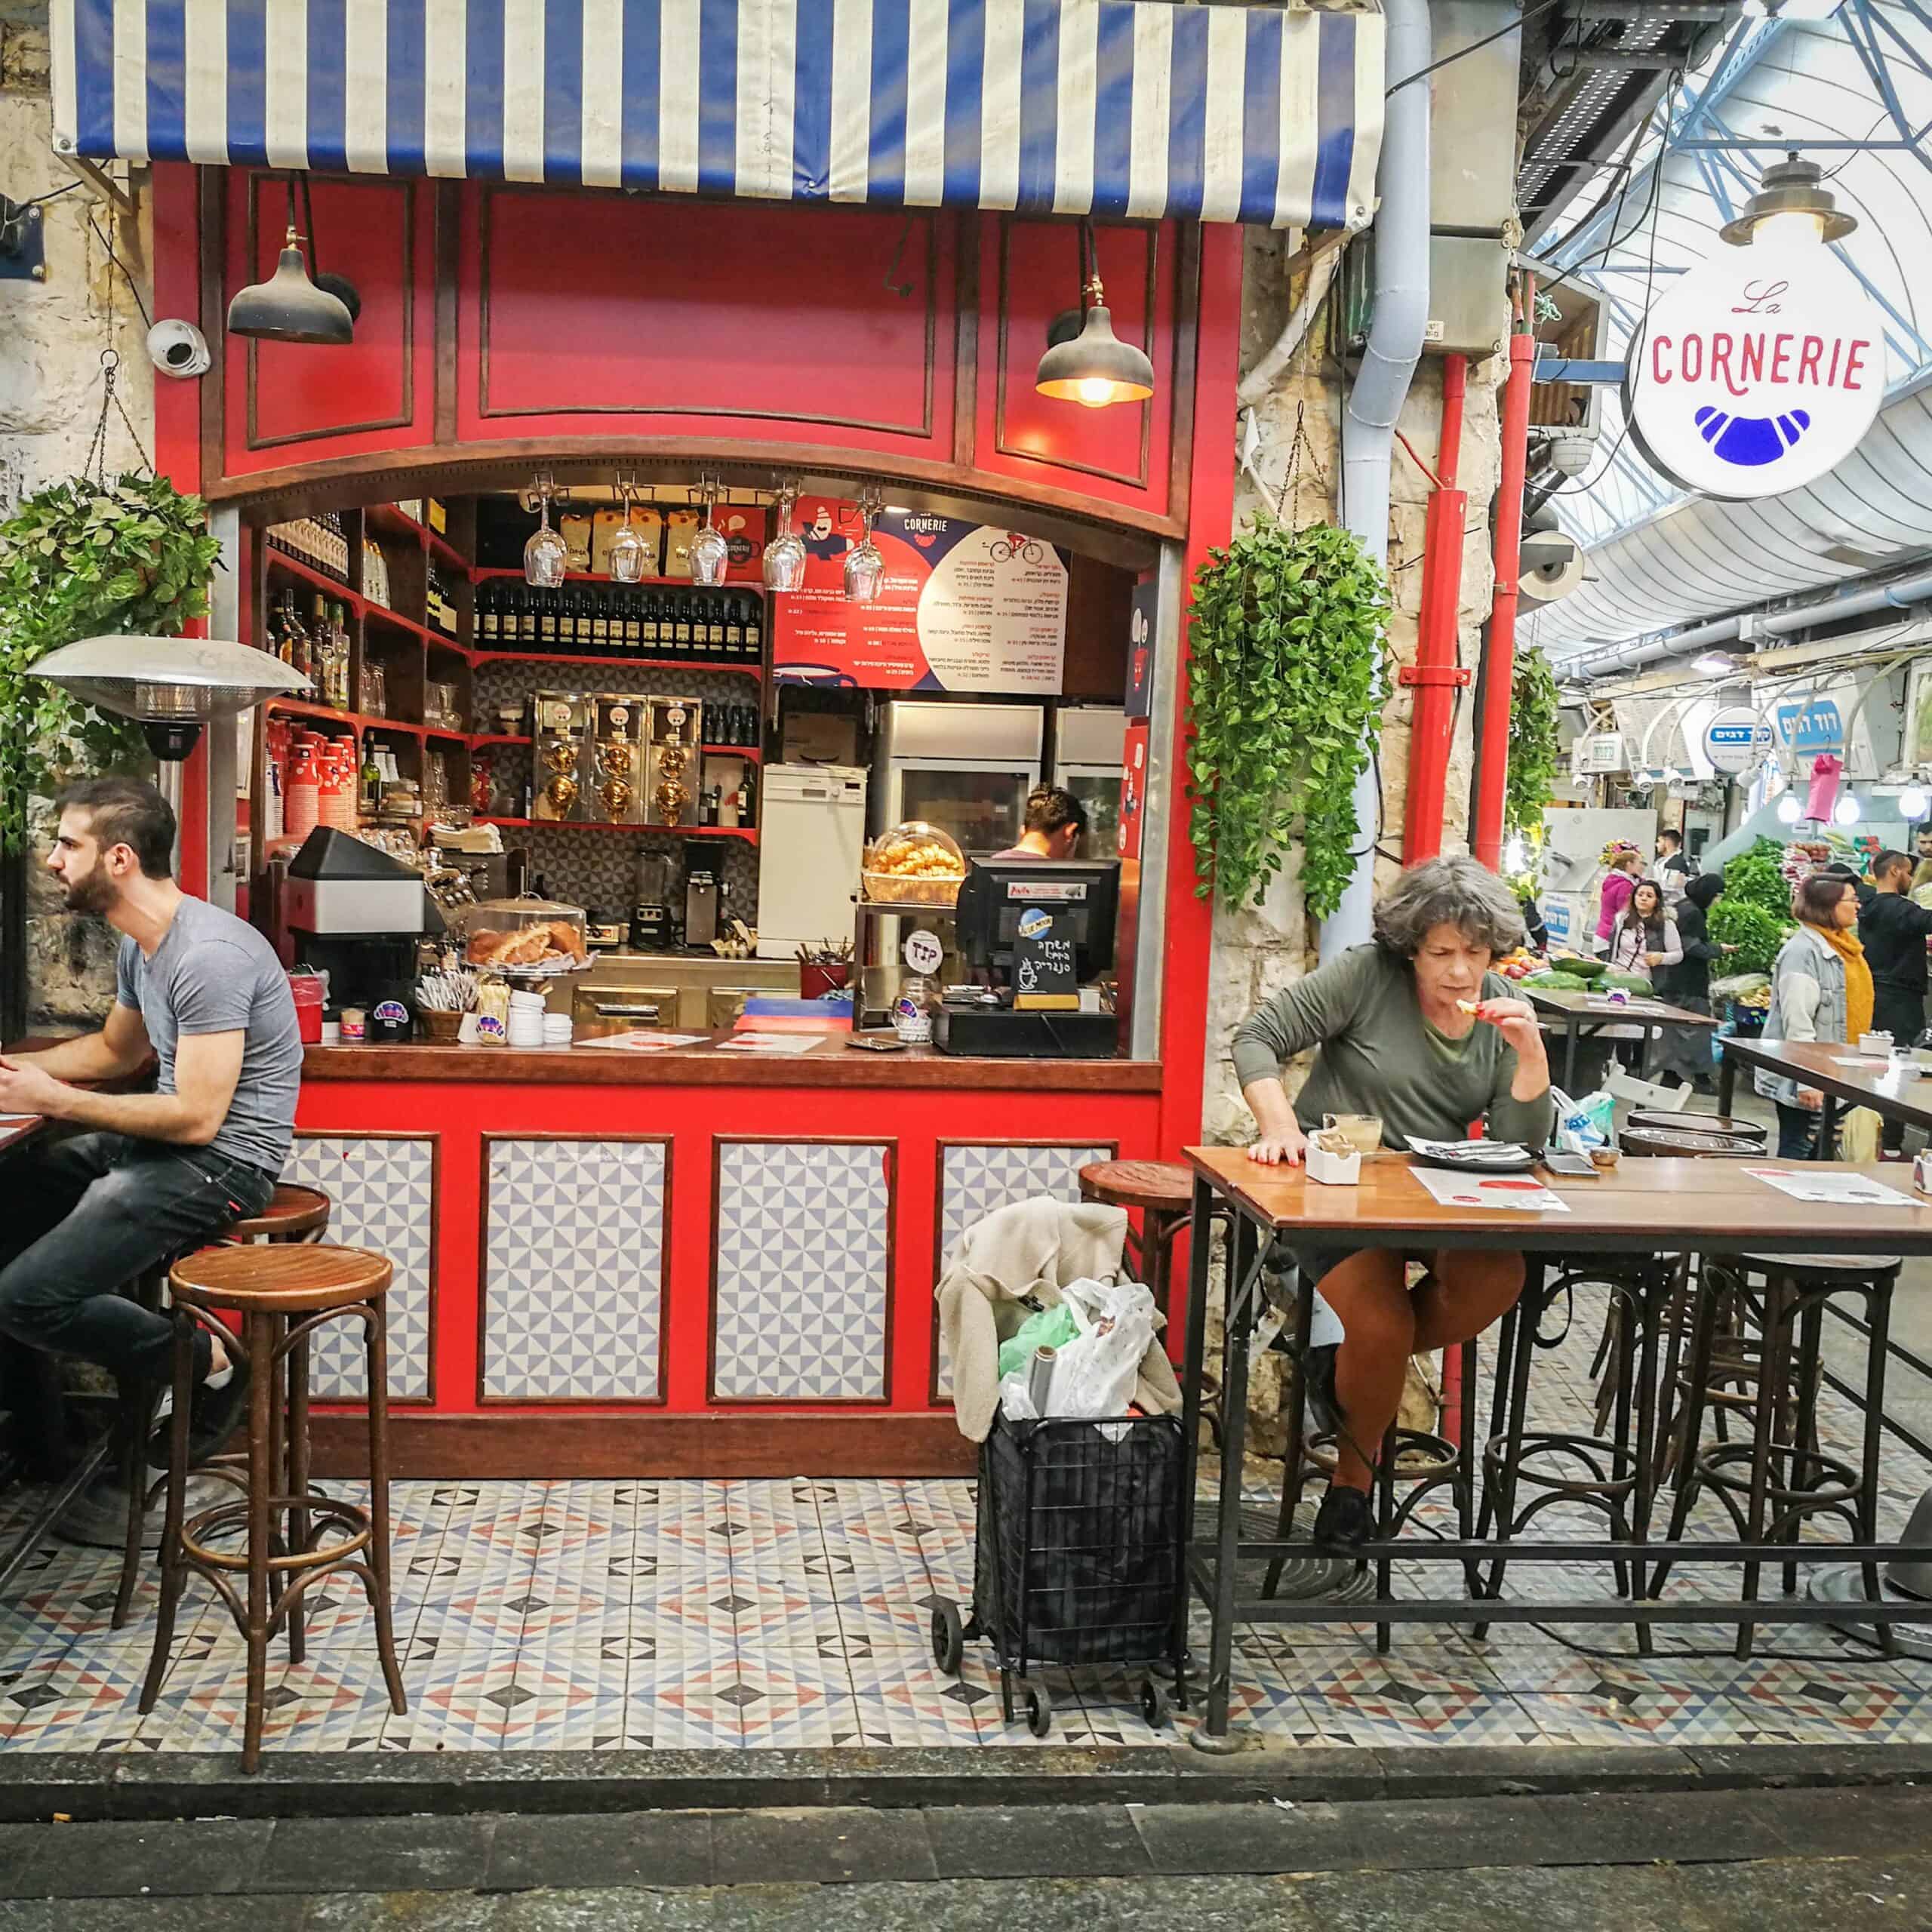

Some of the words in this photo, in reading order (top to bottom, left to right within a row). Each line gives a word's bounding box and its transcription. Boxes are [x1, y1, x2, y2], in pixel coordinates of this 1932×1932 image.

[1731, 279, 1789, 313] La
[1653, 333, 1870, 395] CORNERIE
[904, 518, 948, 533] CORNERIE
[1814, 712, 1837, 731] דוד
[912, 941, 937, 963] TIP
